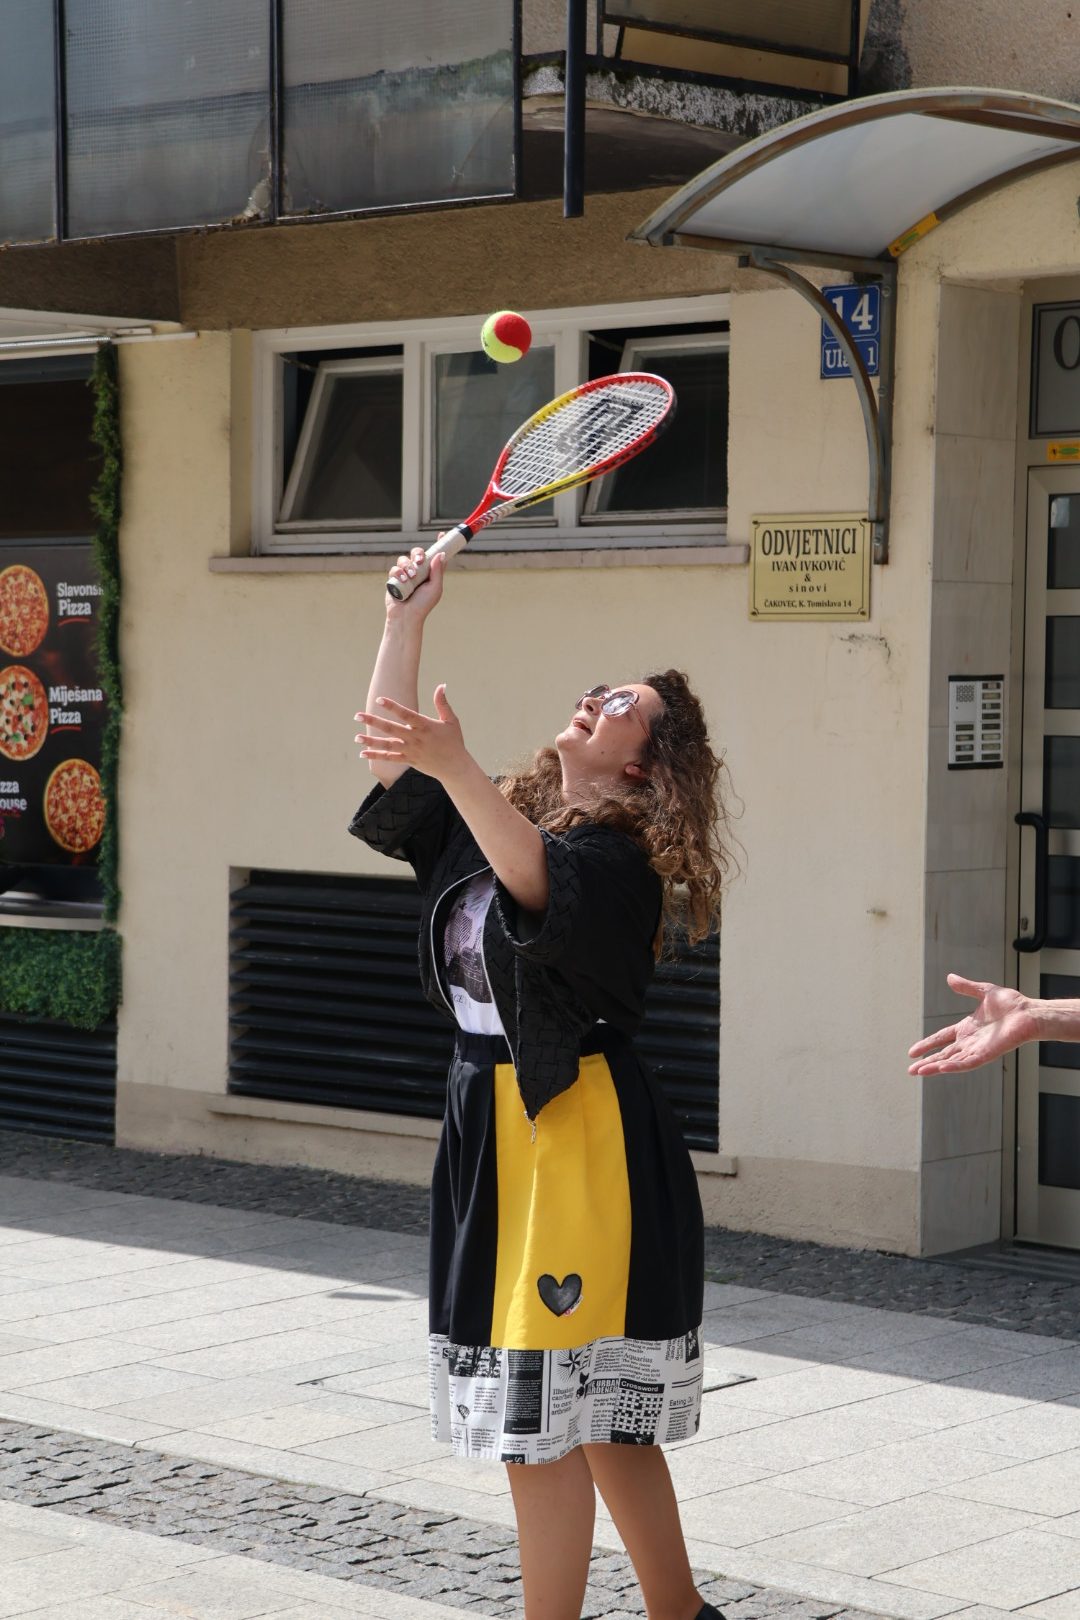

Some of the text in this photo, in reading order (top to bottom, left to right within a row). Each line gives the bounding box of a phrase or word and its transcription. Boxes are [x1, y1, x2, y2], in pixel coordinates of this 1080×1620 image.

[867, 346, 876, 366] 1
[761, 528, 857, 558] ODVJETNICI
[772, 561, 797, 571] IVAN
[804, 573, 811, 582] &
[58, 599, 92, 616] Pizza
[807, 599, 841, 608] Tomislava
[49, 685, 103, 706] Miješana
[50, 708, 82, 724] Pizza
[0, 780, 20, 793] zza
[0, 797, 27, 811] ouse
[623, 1353, 653, 1364] Aquarius
[620, 1380, 660, 1393] Crossword
[669, 1398, 687, 1408] Eating
